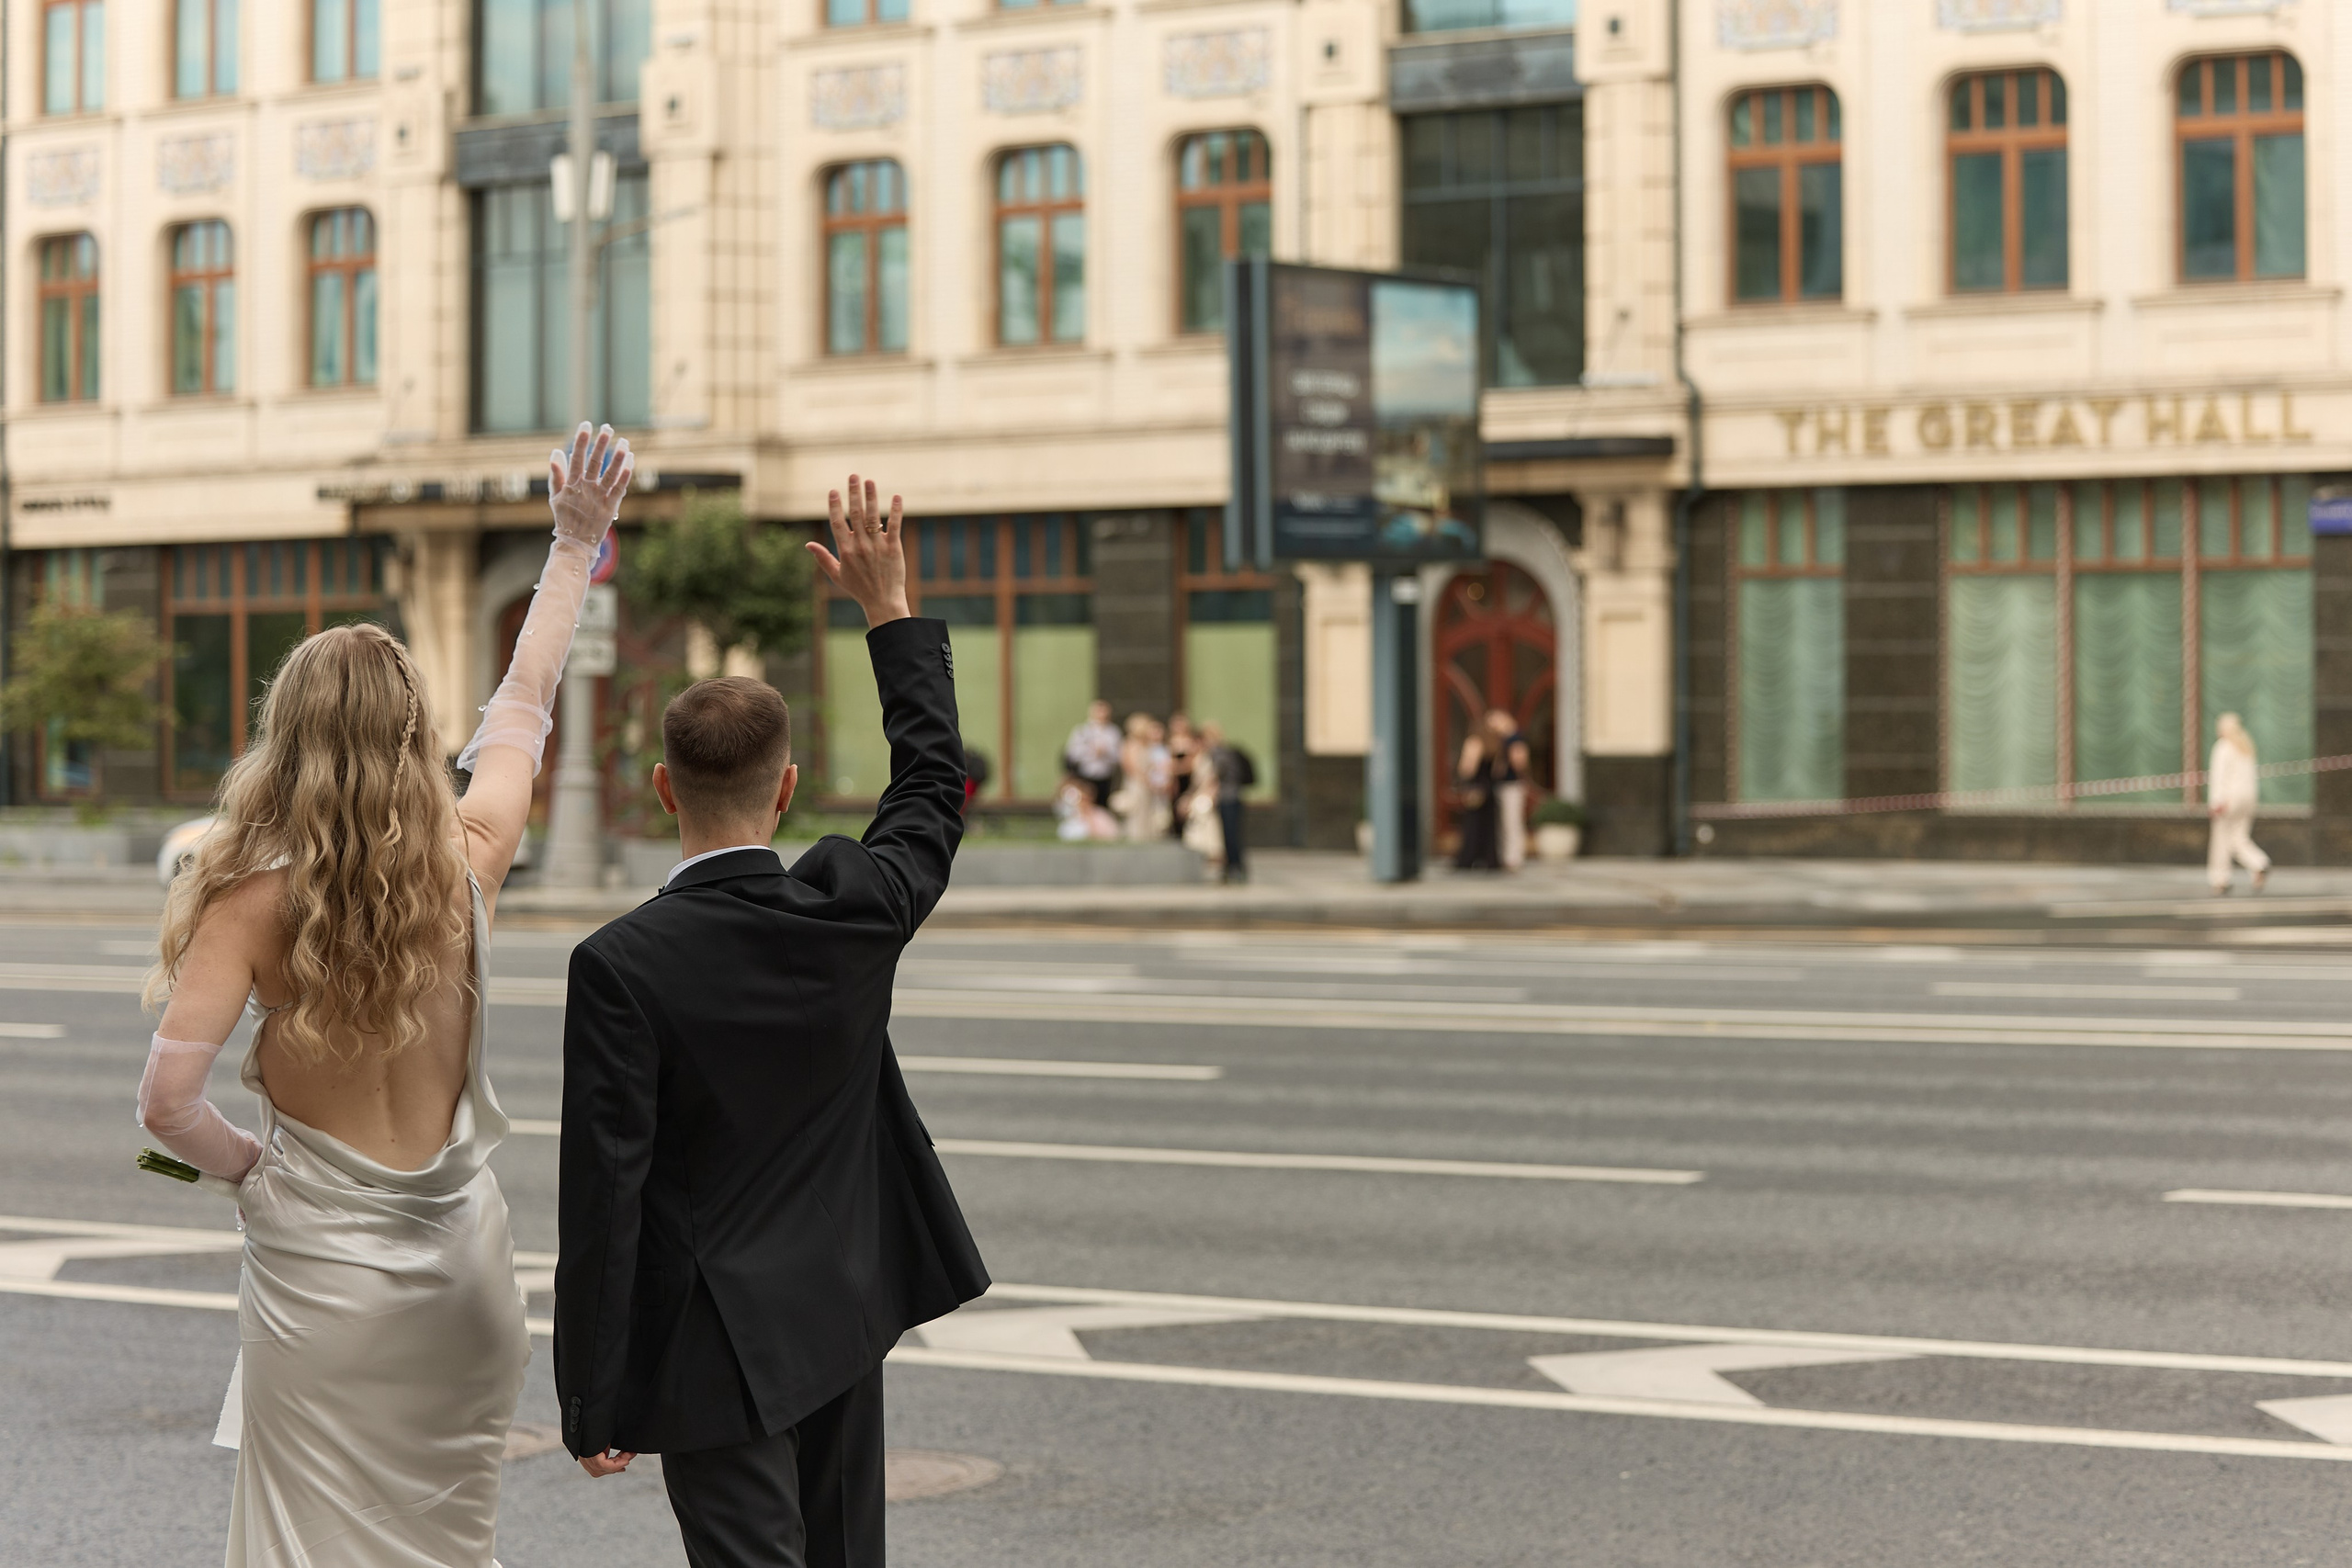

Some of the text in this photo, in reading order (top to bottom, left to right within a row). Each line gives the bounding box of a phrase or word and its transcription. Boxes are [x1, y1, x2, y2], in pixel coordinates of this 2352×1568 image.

[1774, 390, 2313, 455] THE GREAT HALL
